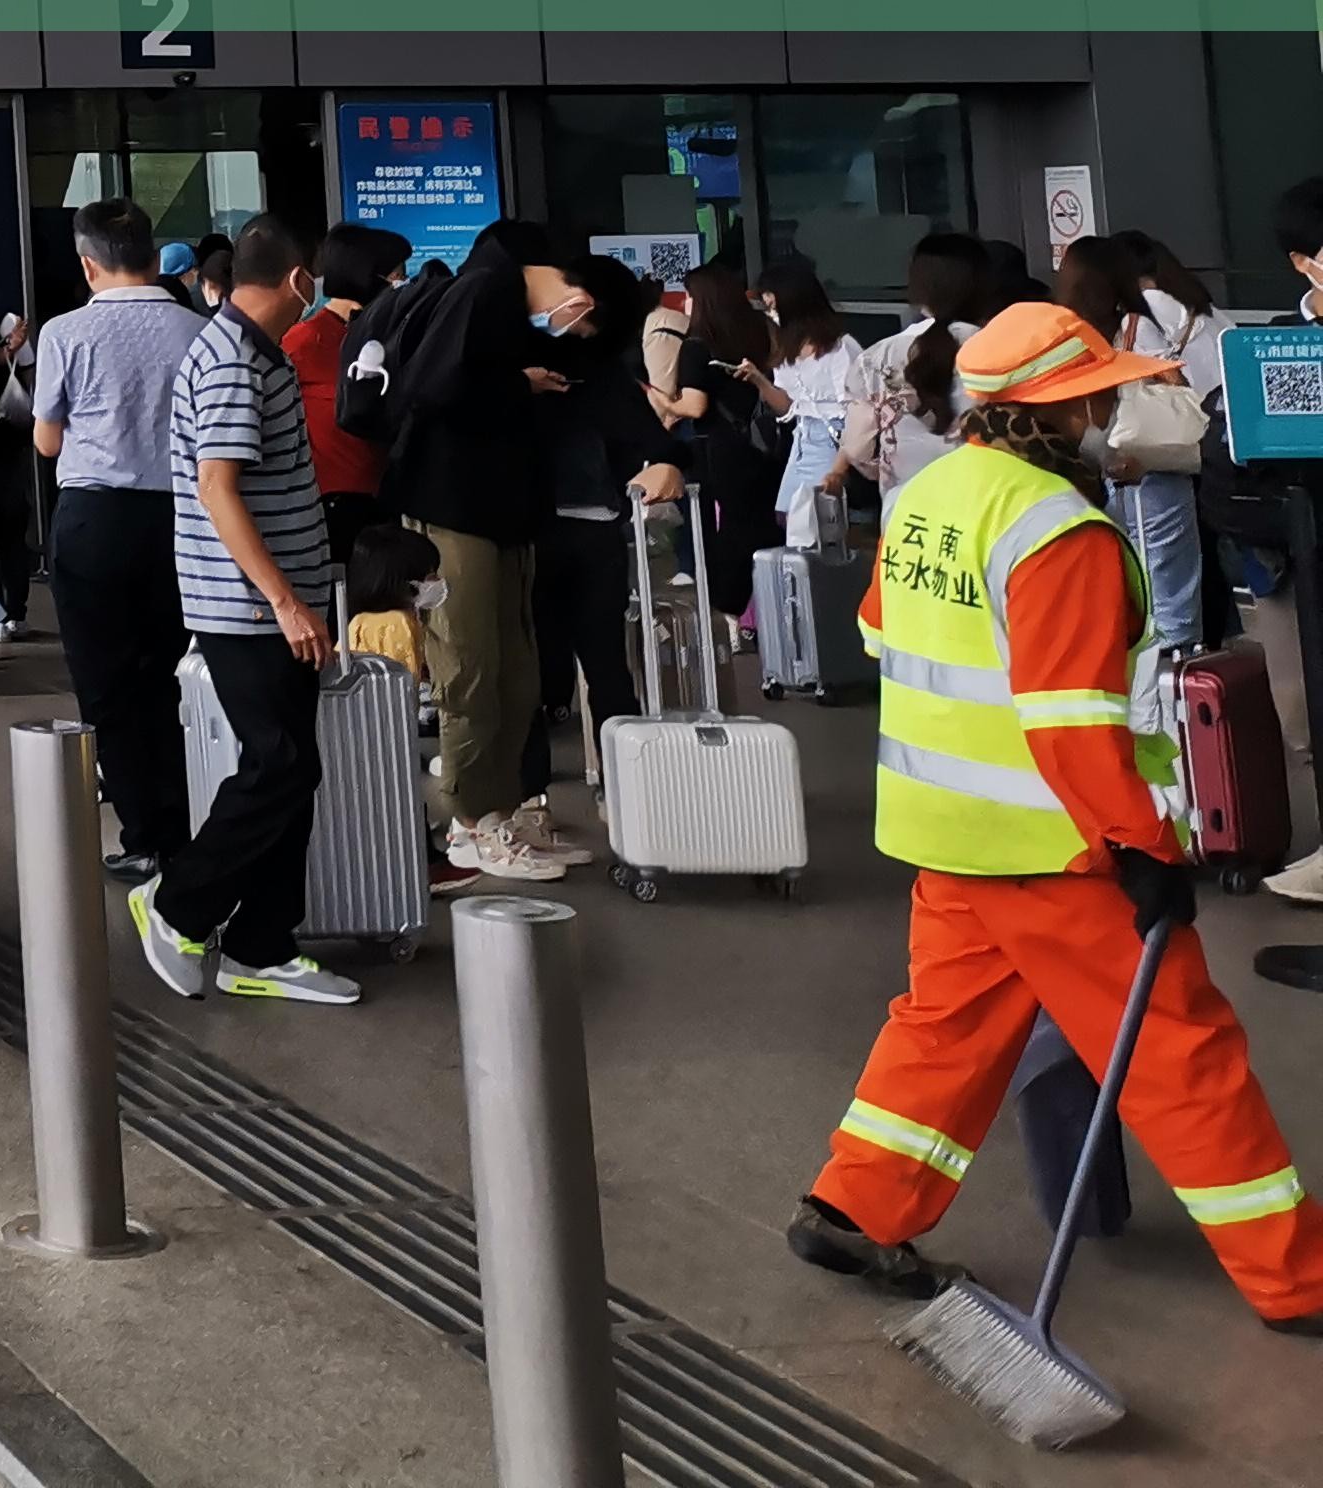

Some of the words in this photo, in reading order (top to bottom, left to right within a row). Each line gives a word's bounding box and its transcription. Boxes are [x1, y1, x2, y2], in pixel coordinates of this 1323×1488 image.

[901, 513, 964, 562] 云南
[880, 546, 984, 609] 长水物业
